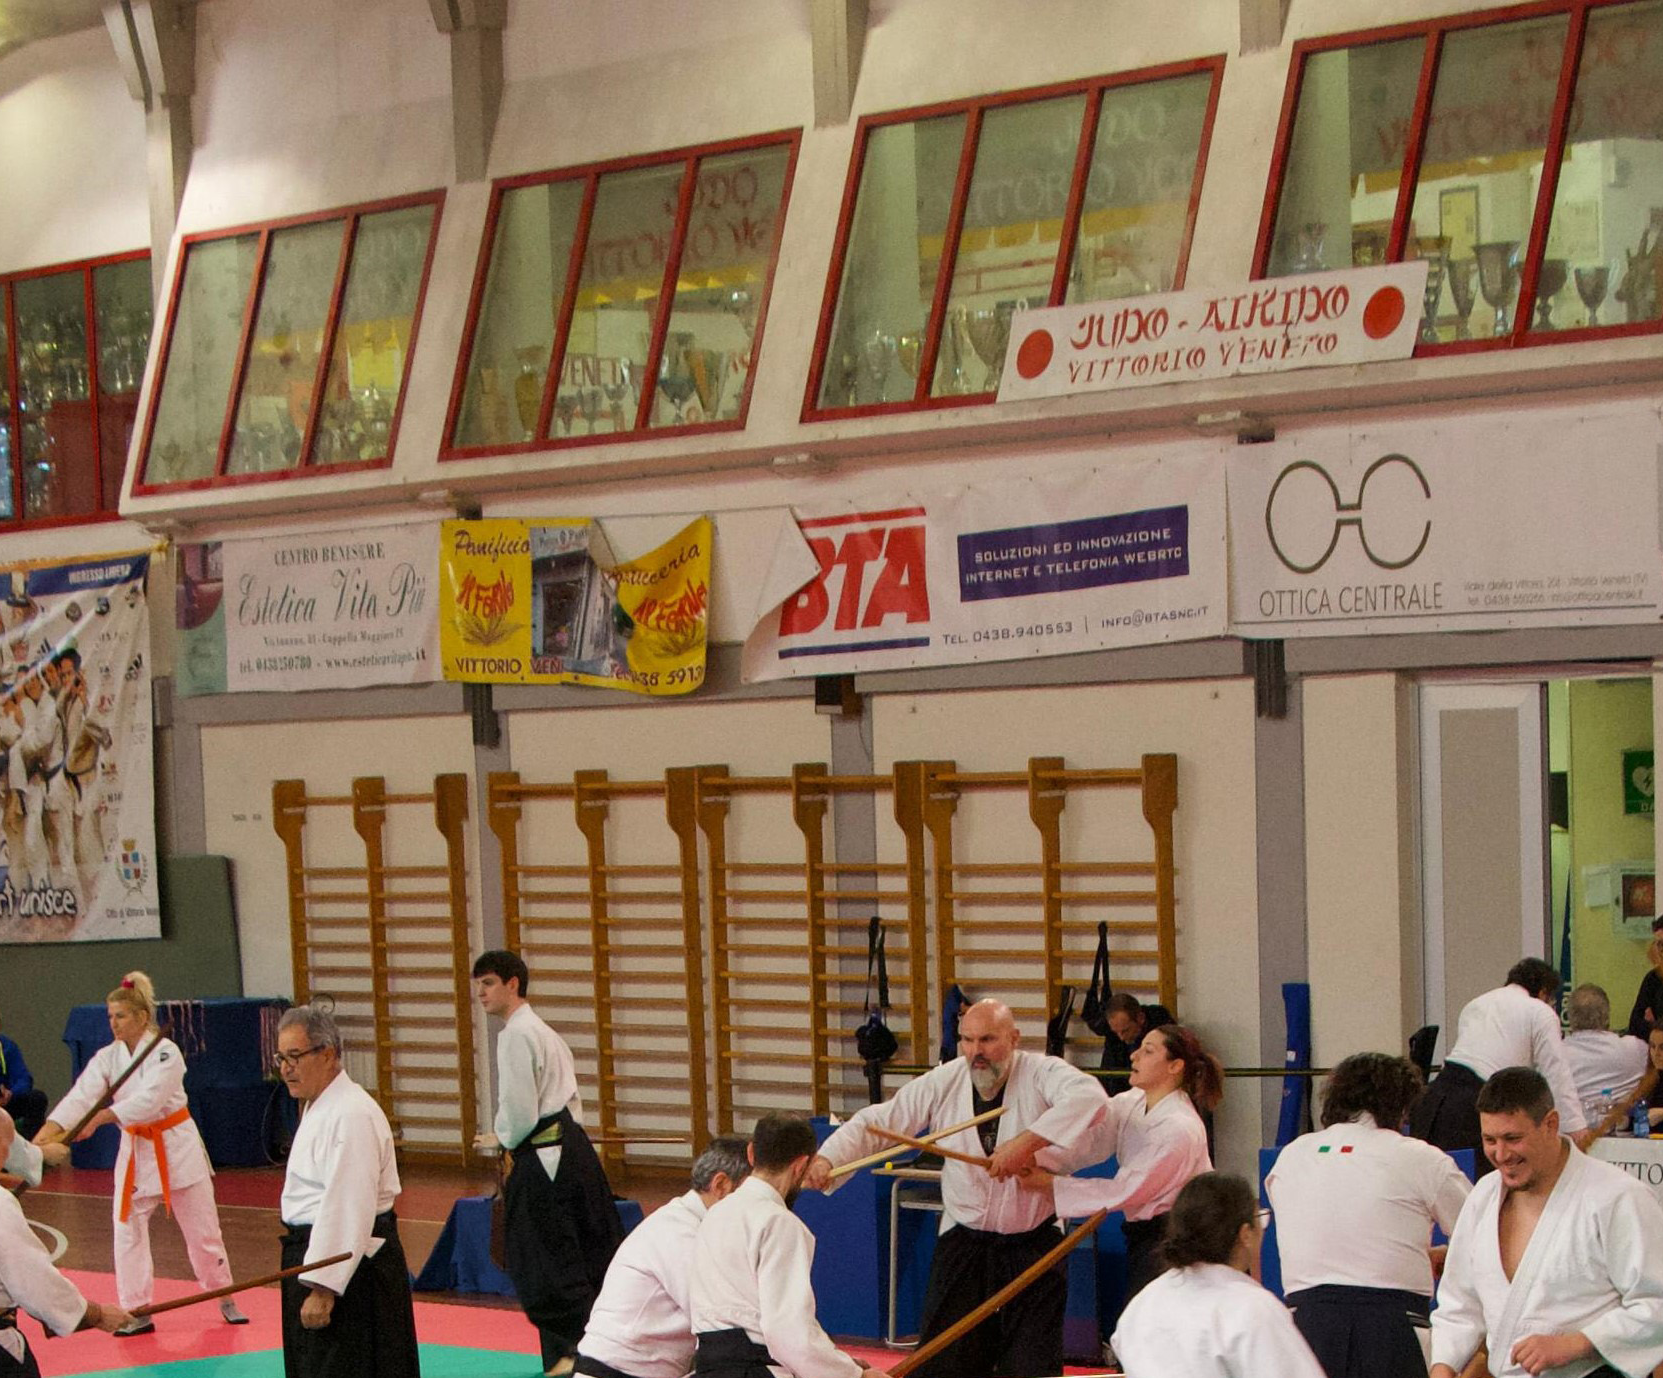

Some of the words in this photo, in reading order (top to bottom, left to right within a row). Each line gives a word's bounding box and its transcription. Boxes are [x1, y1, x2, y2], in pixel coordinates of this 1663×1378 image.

[1070, 307, 1169, 349] JUDO
[1198, 285, 1350, 332] AIKIDO
[1068, 347, 1206, 383] VITTORIO
[1220, 333, 1338, 366] VENETO
[275, 549, 318, 566] CENTRO
[454, 528, 530, 563] Panificio
[975, 546, 1047, 564] SOLUZIONI
[1053, 542, 1072, 555] ED
[1076, 528, 1172, 552] INNOVAZIONE
[779, 525, 930, 637] BTA
[966, 567, 1029, 584] INTERNET
[1033, 564, 1041, 576] E
[1046, 556, 1120, 575] TELEFONIA
[239, 573, 316, 626] Estetica
[333, 567, 377, 621] Vita
[1259, 588, 1332, 617] OTTICA
[1338, 582, 1443, 613] CENTRALE
[943, 634, 968, 645] TEL.
[456, 658, 522, 675] VITTORIO
[19, 883, 77, 918] unisce
